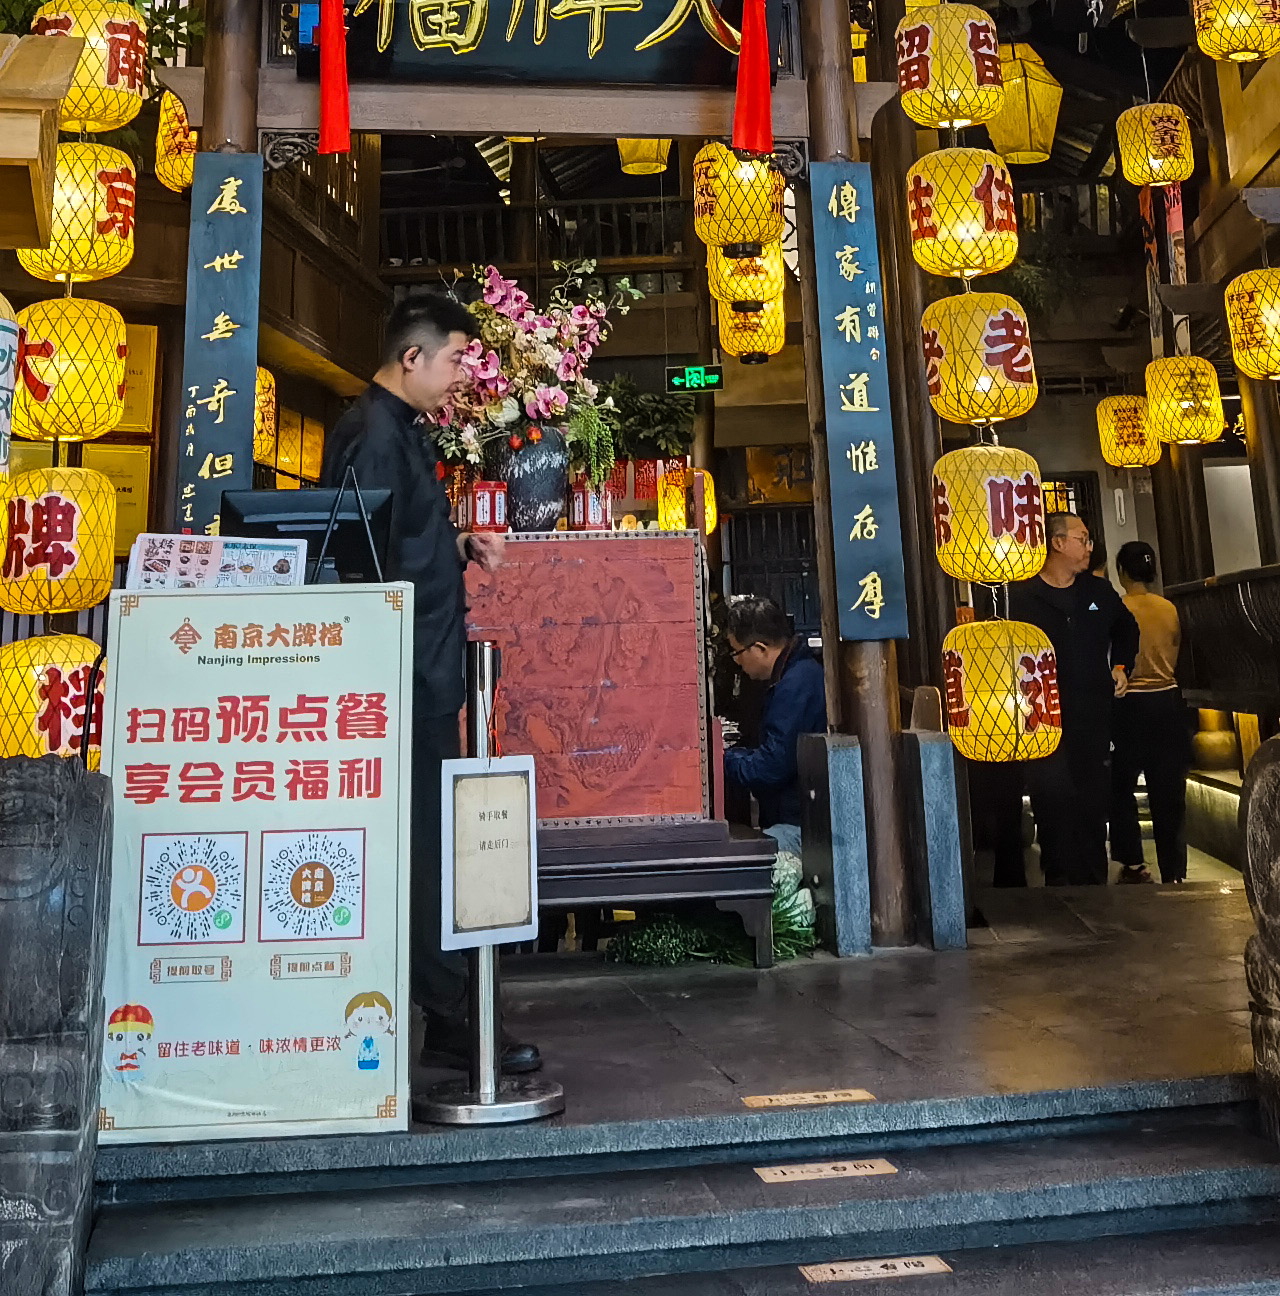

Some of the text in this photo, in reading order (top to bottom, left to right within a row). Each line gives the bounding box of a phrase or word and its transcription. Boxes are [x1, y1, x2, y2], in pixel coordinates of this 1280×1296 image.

[985, 311, 1032, 382] 老
[987, 473, 1044, 548] 味
[3, 494, 77, 579] 牌
[198, 652, 320, 666] Nanjing Impressions
[214, 622, 344, 650] 南京大牌檔
[126, 693, 389, 744] 扫码预点餐
[123, 757, 383, 804] 享会员福利
[478, 810, 508, 821] 骑手取餐
[479, 839, 509, 851] 请走后门
